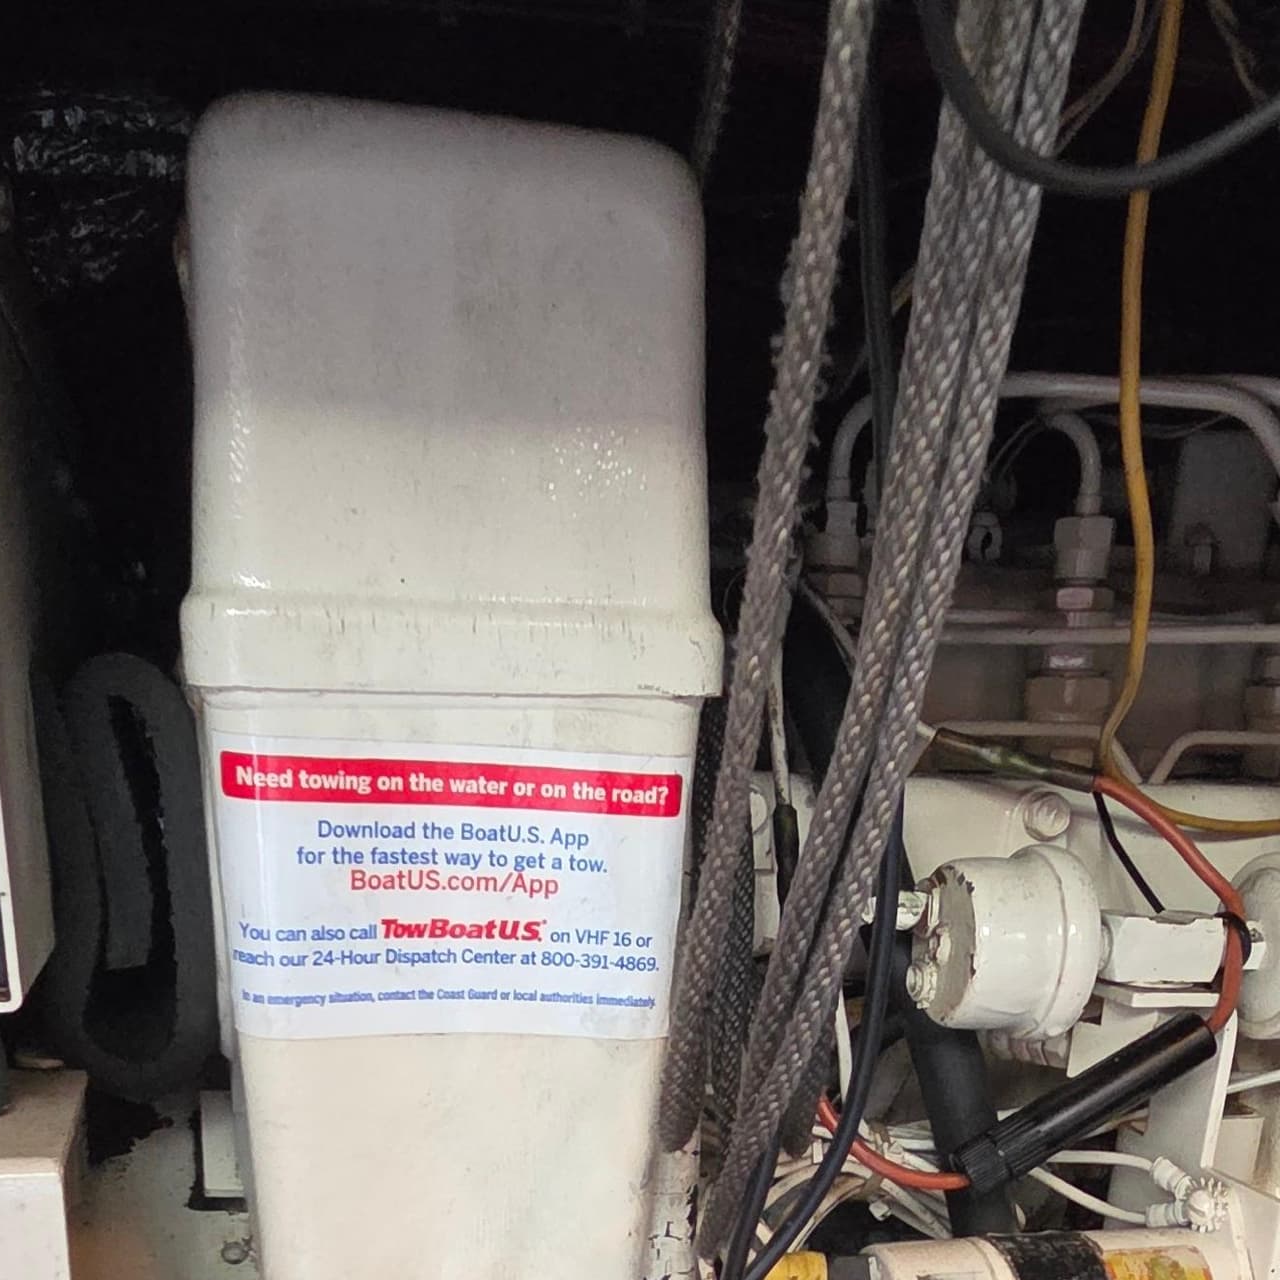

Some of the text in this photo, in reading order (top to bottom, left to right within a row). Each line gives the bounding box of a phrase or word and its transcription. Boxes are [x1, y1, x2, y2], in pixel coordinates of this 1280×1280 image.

[235, 766, 670, 806] Need towing on the water or on the road?
[317, 820, 590, 850] Download the BoatU.S. App
[297, 846, 608, 874] for the fastest way to get a tow.
[350, 869, 560, 899] BoatUS.com/App
[238, 921, 270, 941] You
[275, 927, 307, 942] can
[311, 925, 346, 941] also
[349, 924, 377, 940] call
[550, 931, 571, 944] on
[575, 929, 611, 946] VHF
[614, 932, 632, 948] 16
[636, 936, 653, 949] or
[233, 948, 661, 973] reach our 24-Hour Dispatch Center at 800-391-4869.
[267, 994, 327, 1008] emergency
[378, 989, 416, 1001] contact
[418, 989, 435, 1001] the
[437, 988, 466, 1001] Coast
[468, 988, 498, 1001] Guard
[500, 991, 511, 1001] or
[513, 989, 538, 1002] local
[539, 992, 594, 1005] authorities
